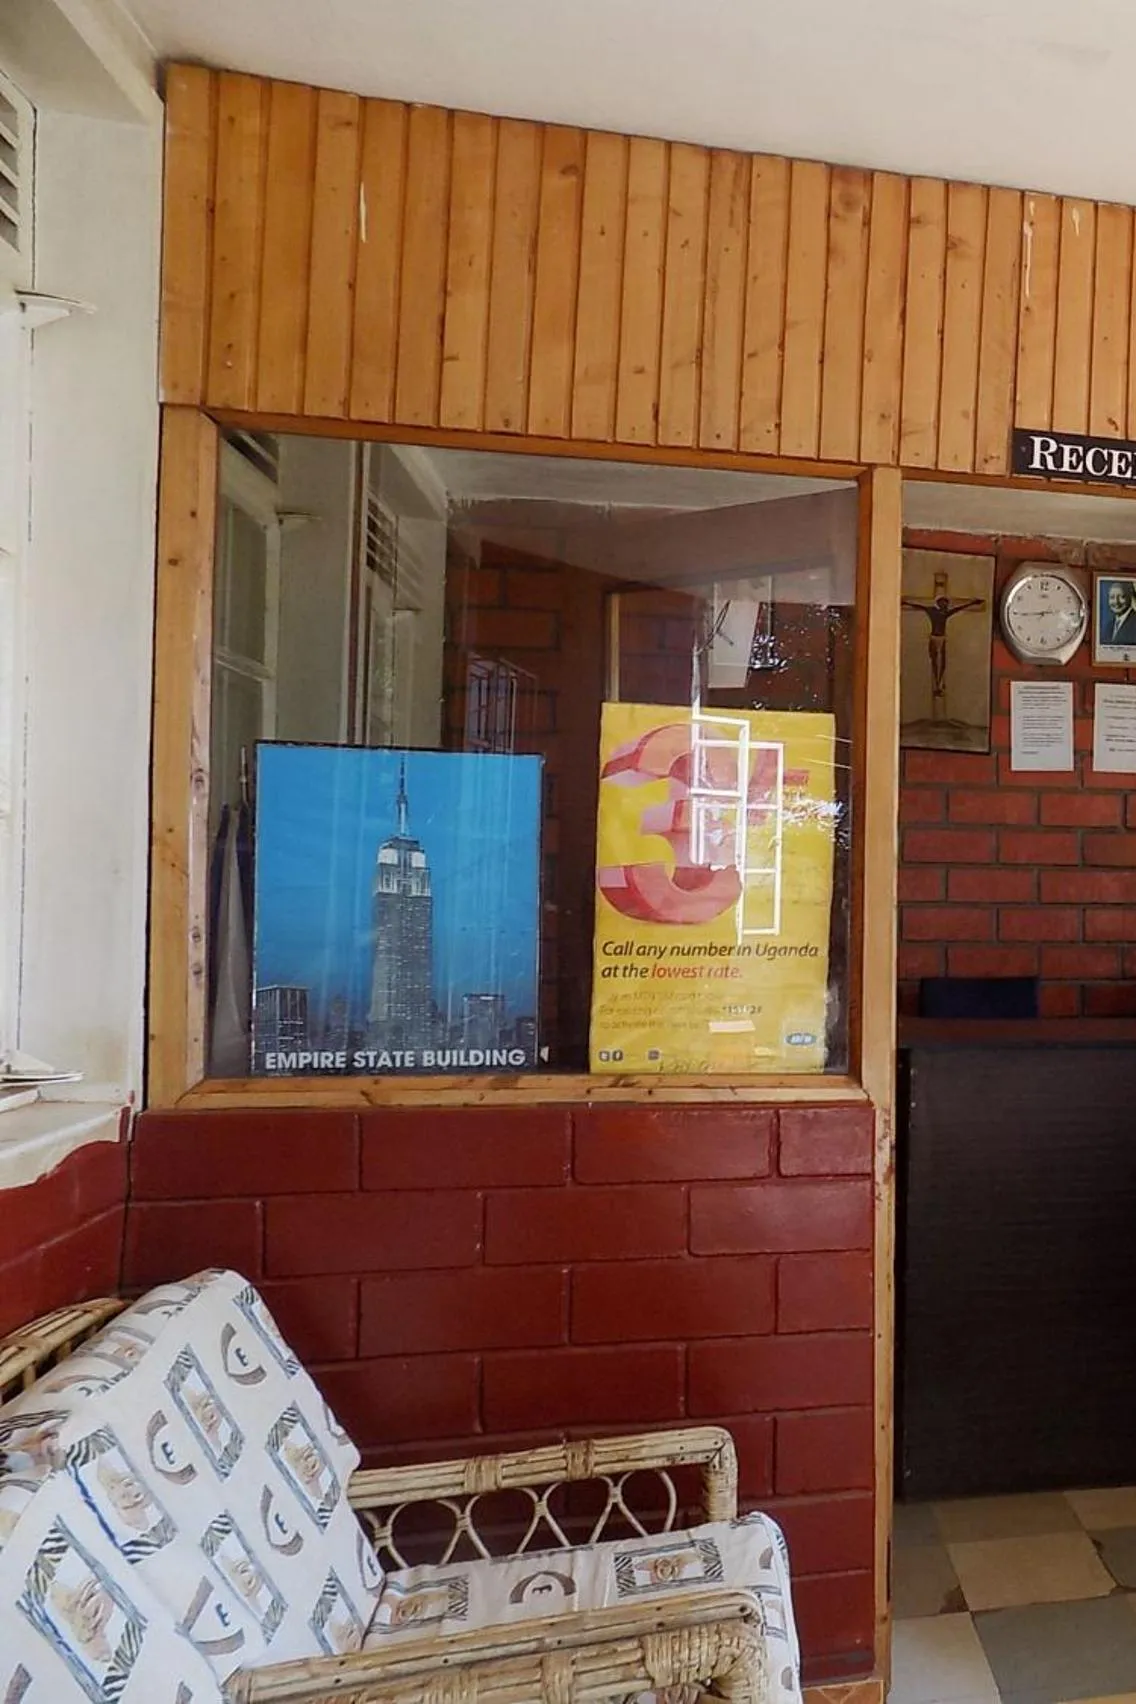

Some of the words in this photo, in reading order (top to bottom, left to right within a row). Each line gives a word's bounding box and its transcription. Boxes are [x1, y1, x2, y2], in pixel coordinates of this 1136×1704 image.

[602, 941, 634, 957] Call
[635, 945, 667, 960] any
[670, 942, 733, 957] number
[755, 943, 819, 960] Uganda
[601, 965, 620, 978] at
[622, 963, 650, 978] the
[651, 964, 704, 979] lowest
[265, 1051, 347, 1070] EMPIRE
[353, 1050, 415, 1069] STATE
[423, 1049, 526, 1068] BUILDING
